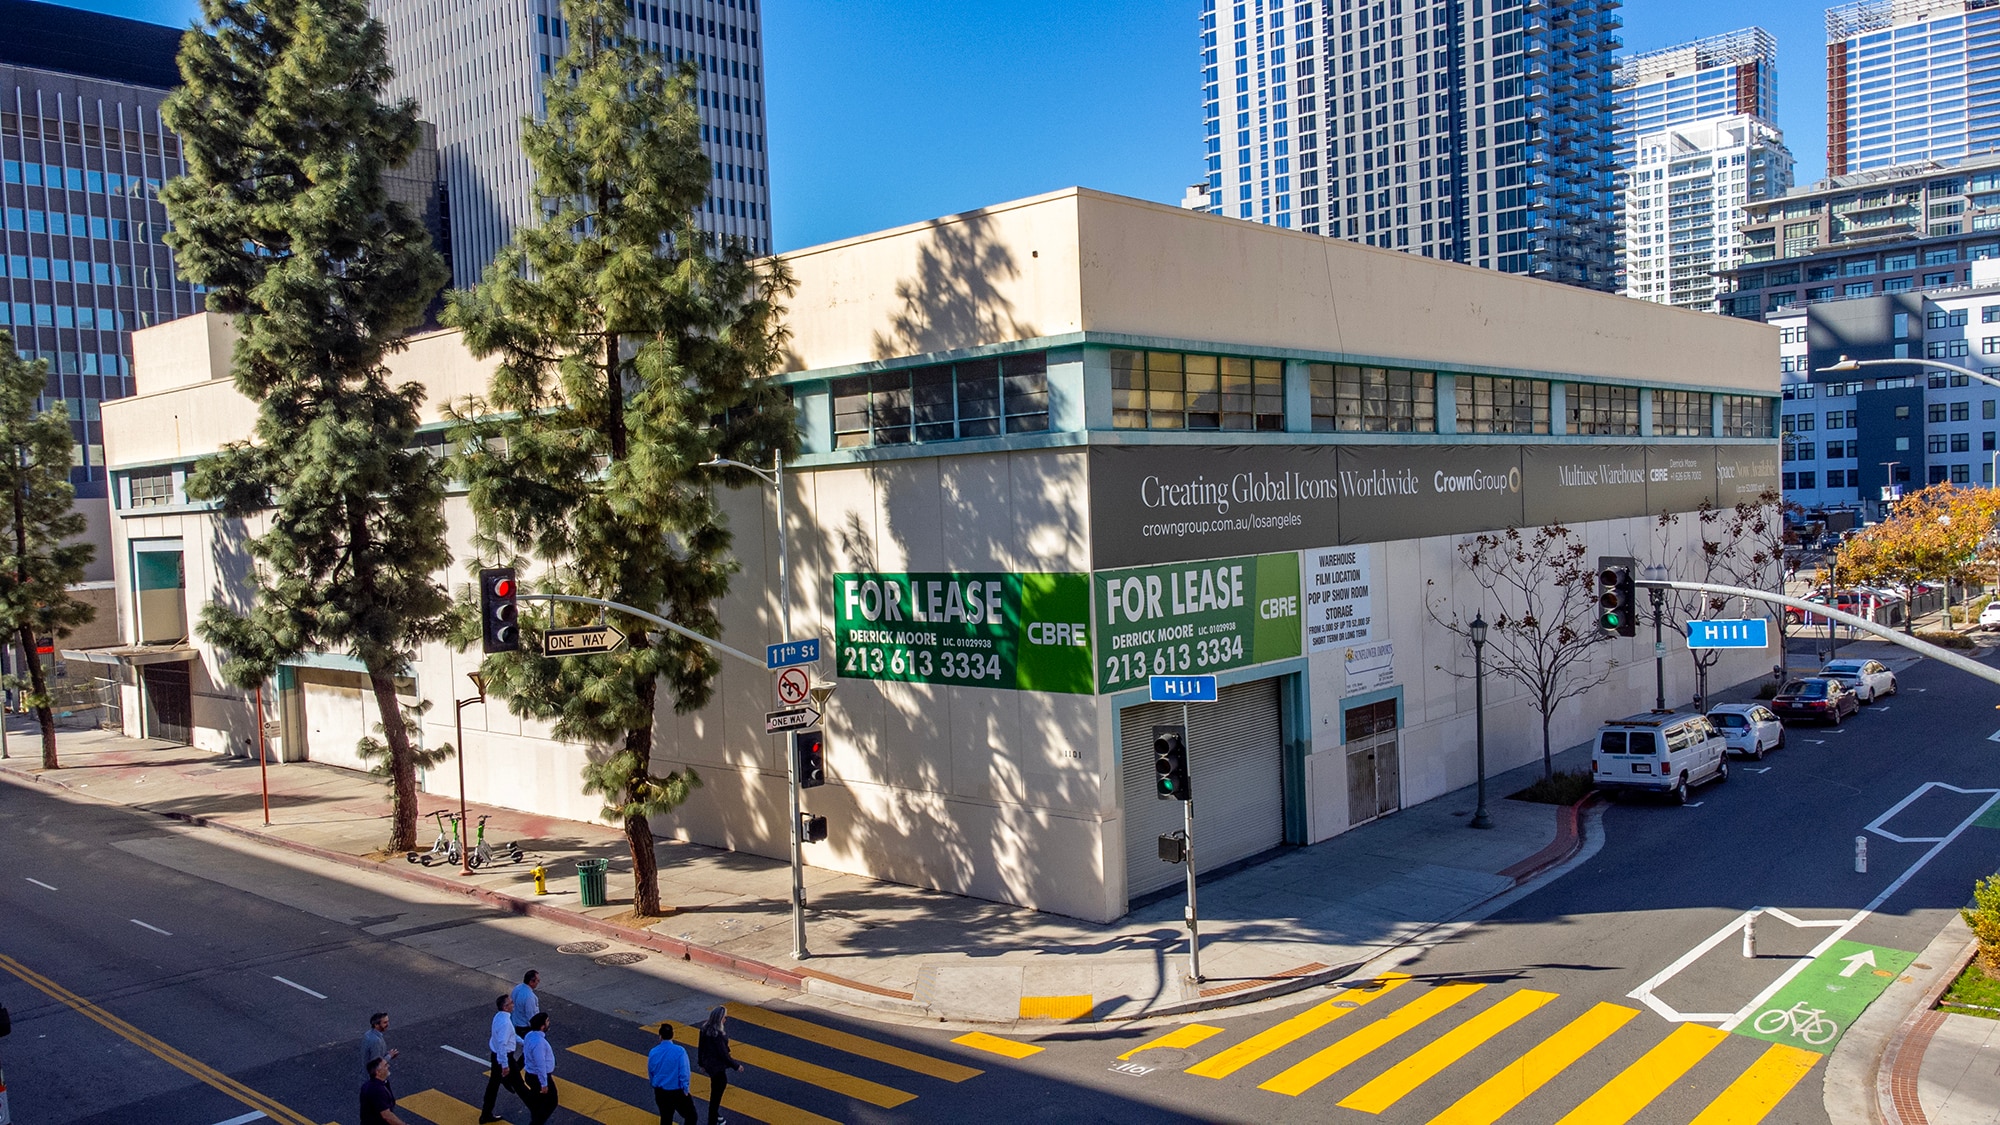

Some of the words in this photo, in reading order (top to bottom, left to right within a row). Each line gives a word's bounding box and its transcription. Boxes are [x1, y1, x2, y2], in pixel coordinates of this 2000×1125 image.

[1434, 468, 1507, 495] CrownGroup
[1559, 464, 1598, 486] Multiuse
[1599, 463, 1645, 484] Warehouse
[1650, 468, 1668, 481] CBRE
[1717, 461, 1735, 485] Space
[1141, 475, 1229, 514] Creating
[1232, 471, 1290, 504] Global
[1294, 472, 1338, 499] Icons
[1339, 468, 1419, 497] Worldwide
[1143, 512, 1302, 537] crowngroup.com.au/losangeles
[1319, 552, 1356, 567] WAREHOUSE
[1315, 573, 1330, 586] FILM
[1332, 569, 1360, 584] LOCATION
[844, 580, 903, 621] FOR
[911, 580, 1003, 625] LEASE
[1107, 575, 1164, 625] FOR
[1171, 565, 1244, 616] LEASE
[1308, 591, 1321, 605] POP
[1322, 590, 1330, 603] UP
[1331, 588, 1350, 602] SHOW
[1351, 585, 1368, 599] ROOM
[1260, 595, 1297, 620] CBRE
[1325, 605, 1353, 620] STORAGE
[850, 629, 893, 644] DERRICK
[896, 632, 937, 646] MOORE
[943, 638, 955, 647] LIC.
[957, 638, 992, 648] 01029938
[1027, 622, 1086, 647] CBRE
[1112, 630, 1156, 650] DERRICK
[1157, 623, 1194, 643] MOORE
[1209, 622, 1236, 634] 01029938
[1309, 625, 1321, 635] FROM
[1312, 636, 1326, 646] SHORT
[1327, 634, 1338, 643] TERM
[1345, 631, 1355, 640] LONG
[1356, 629, 1367, 638] TERM
[1704, 625, 1748, 640] Hill
[551, 635, 574, 649] ONE
[582, 633, 606, 646] WAY
[772, 646, 796, 664] 11th
[801, 644, 815, 658] St
[844, 647, 884, 673] 213
[891, 649, 933, 676] 613
[940, 652, 1002, 680] 3334
[1106, 651, 1147, 684] 213
[1153, 643, 1191, 675] 613
[1196, 635, 1244, 667] 3334
[1165, 680, 1201, 694] Hill
[771, 717, 787, 727] ONE
[790, 714, 806, 723] WAY
